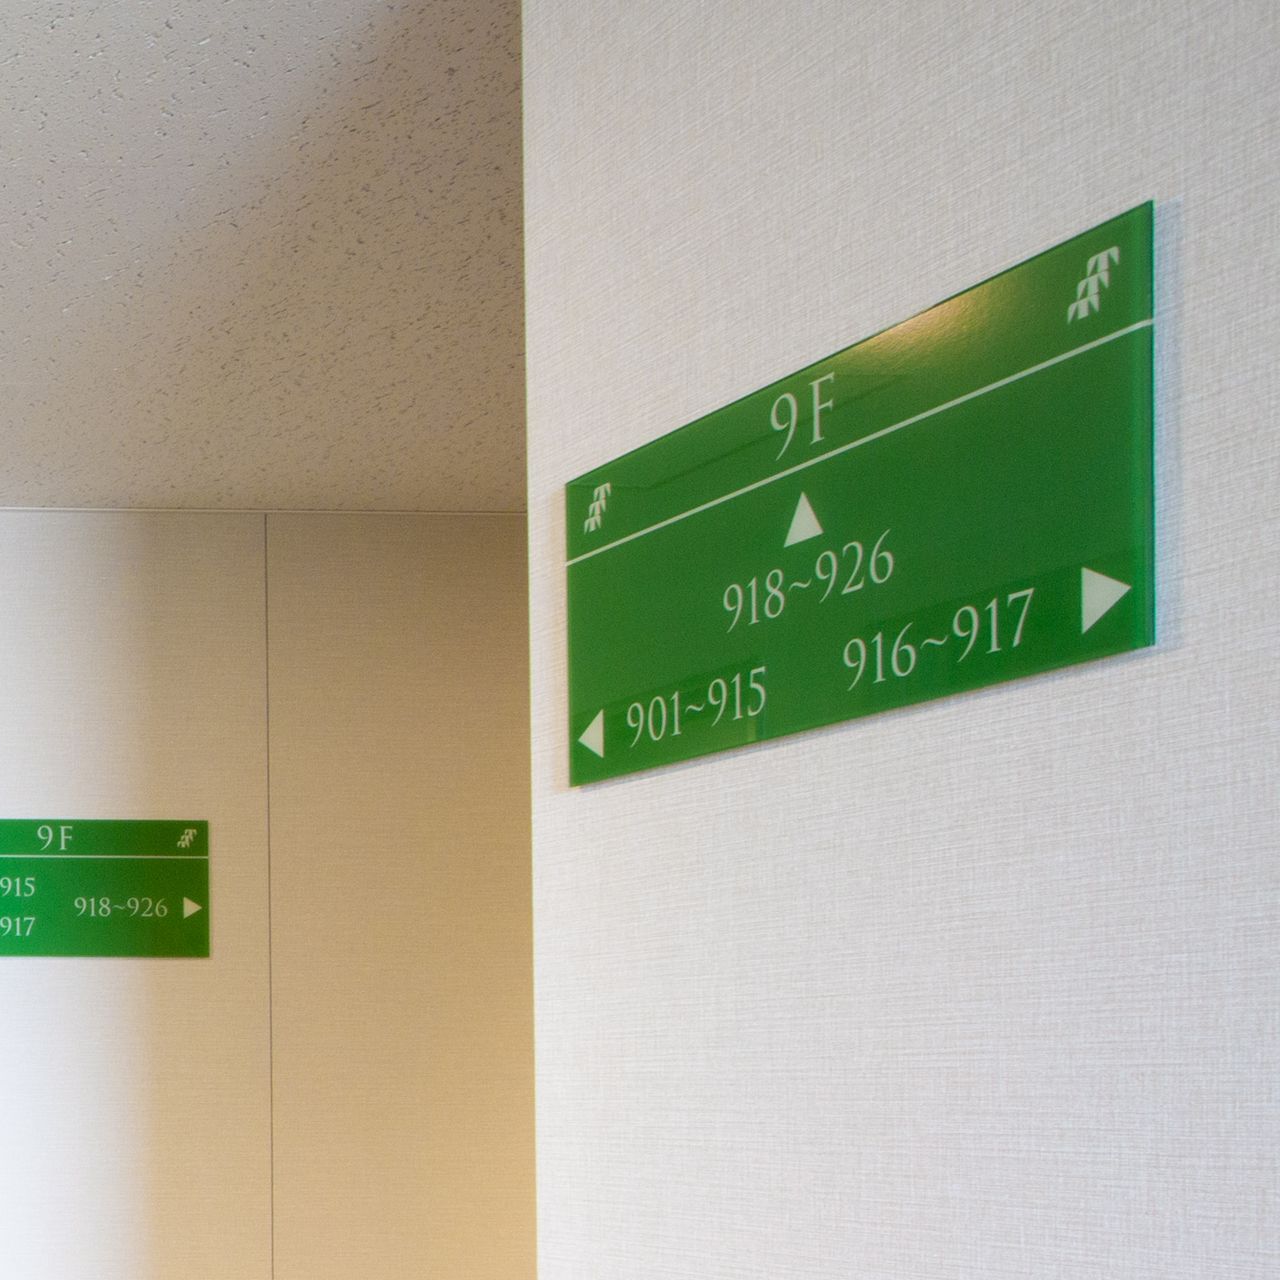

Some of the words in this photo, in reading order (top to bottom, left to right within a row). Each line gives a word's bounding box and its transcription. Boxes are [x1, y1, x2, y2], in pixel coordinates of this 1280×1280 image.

[770, 372, 836, 460] 9F
[723, 530, 895, 634] 918~926
[843, 588, 1035, 691] 916~917
[627, 666, 768, 748] 901~915
[37, 825, 73, 850] 9F
[74, 897, 168, 918] 918~926
